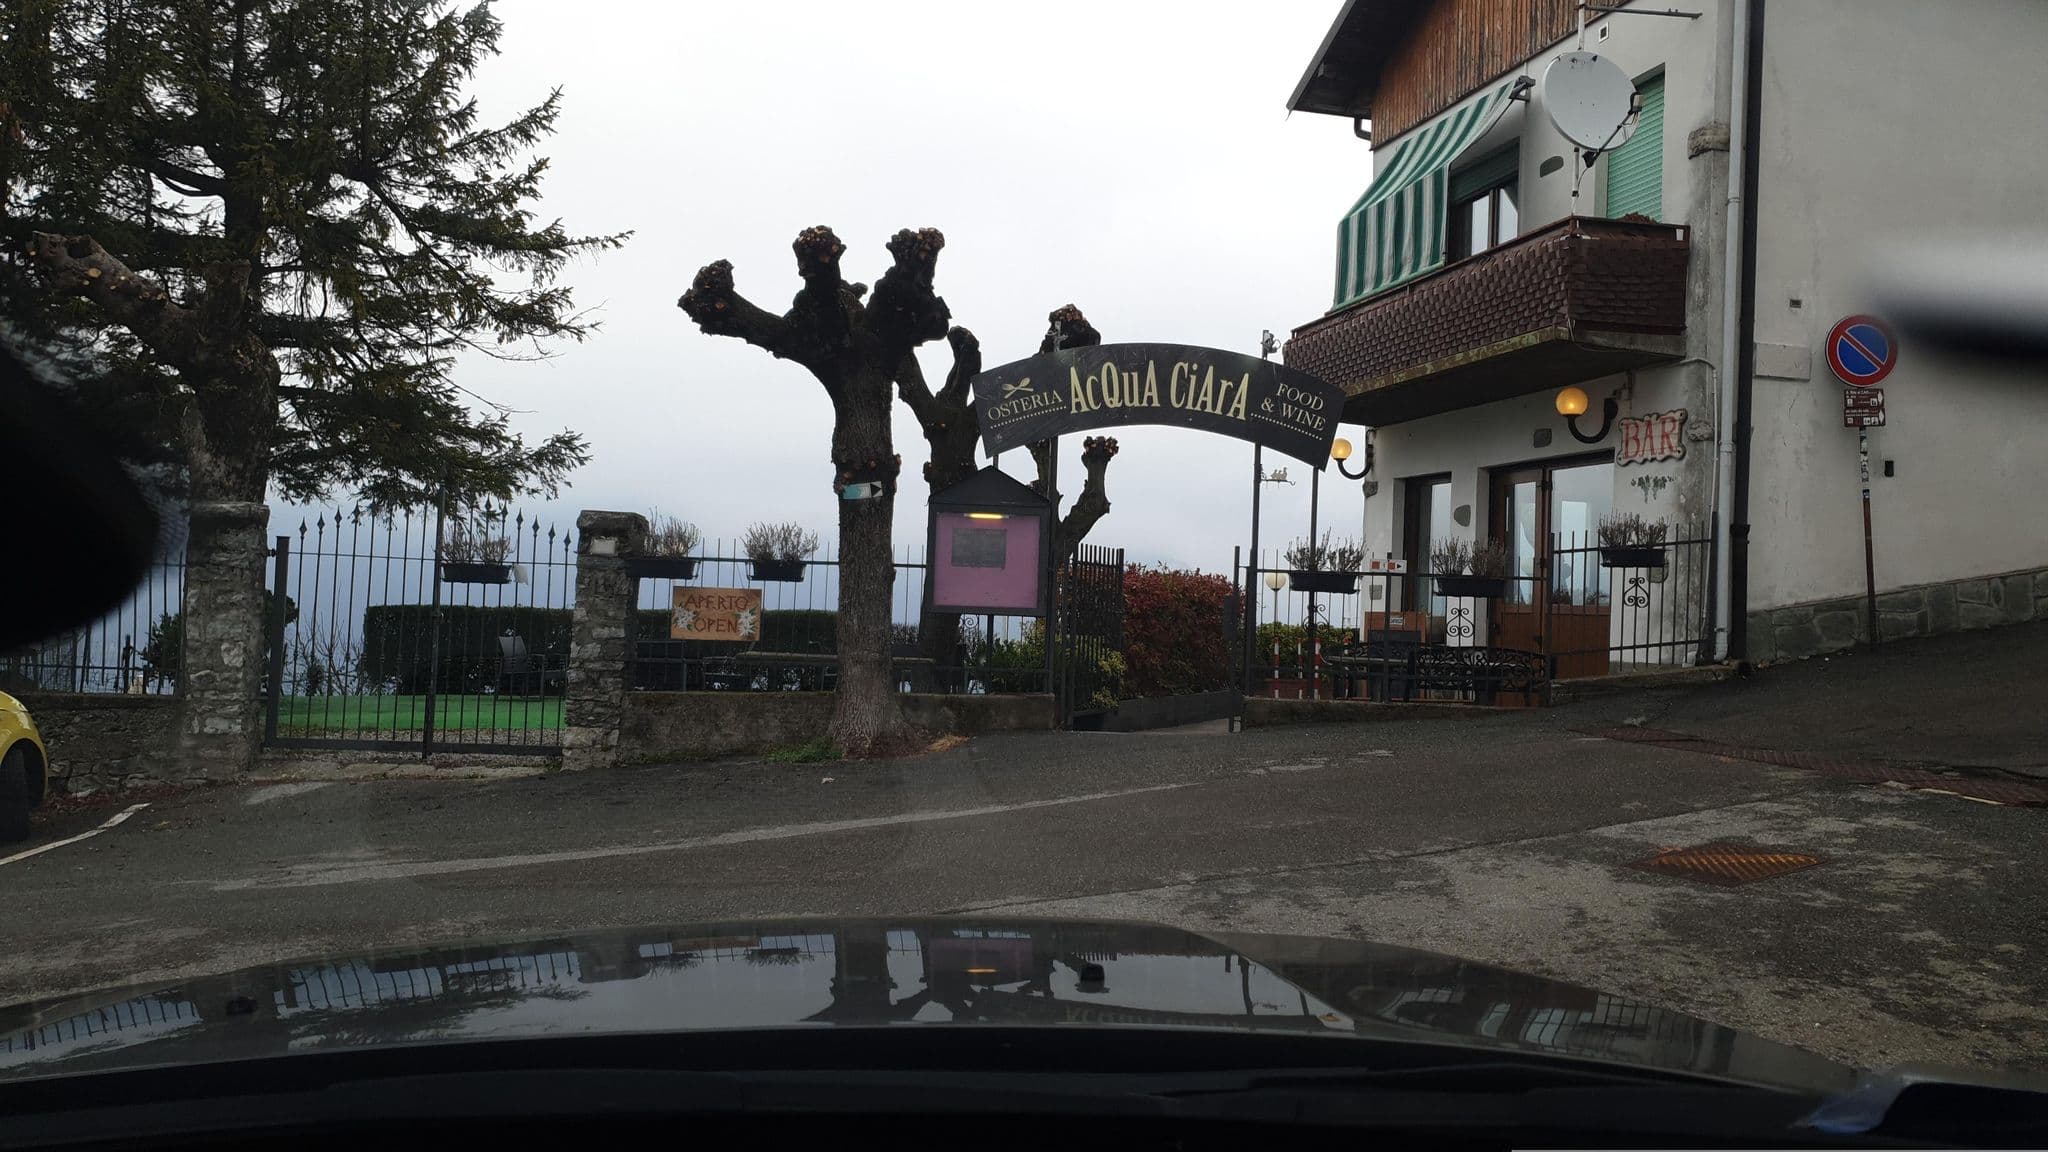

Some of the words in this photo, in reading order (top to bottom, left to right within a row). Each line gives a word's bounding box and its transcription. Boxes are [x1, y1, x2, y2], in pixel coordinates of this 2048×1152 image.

[988, 390, 1063, 420] OSTERIA
[1276, 383, 1324, 411] FOOD
[1261, 397, 1274, 412] &
[1282, 403, 1326, 431] WINE
[1622, 415, 1678, 459] BAR
[684, 594, 749, 610] APERTO
[694, 619, 738, 633] OPEN
